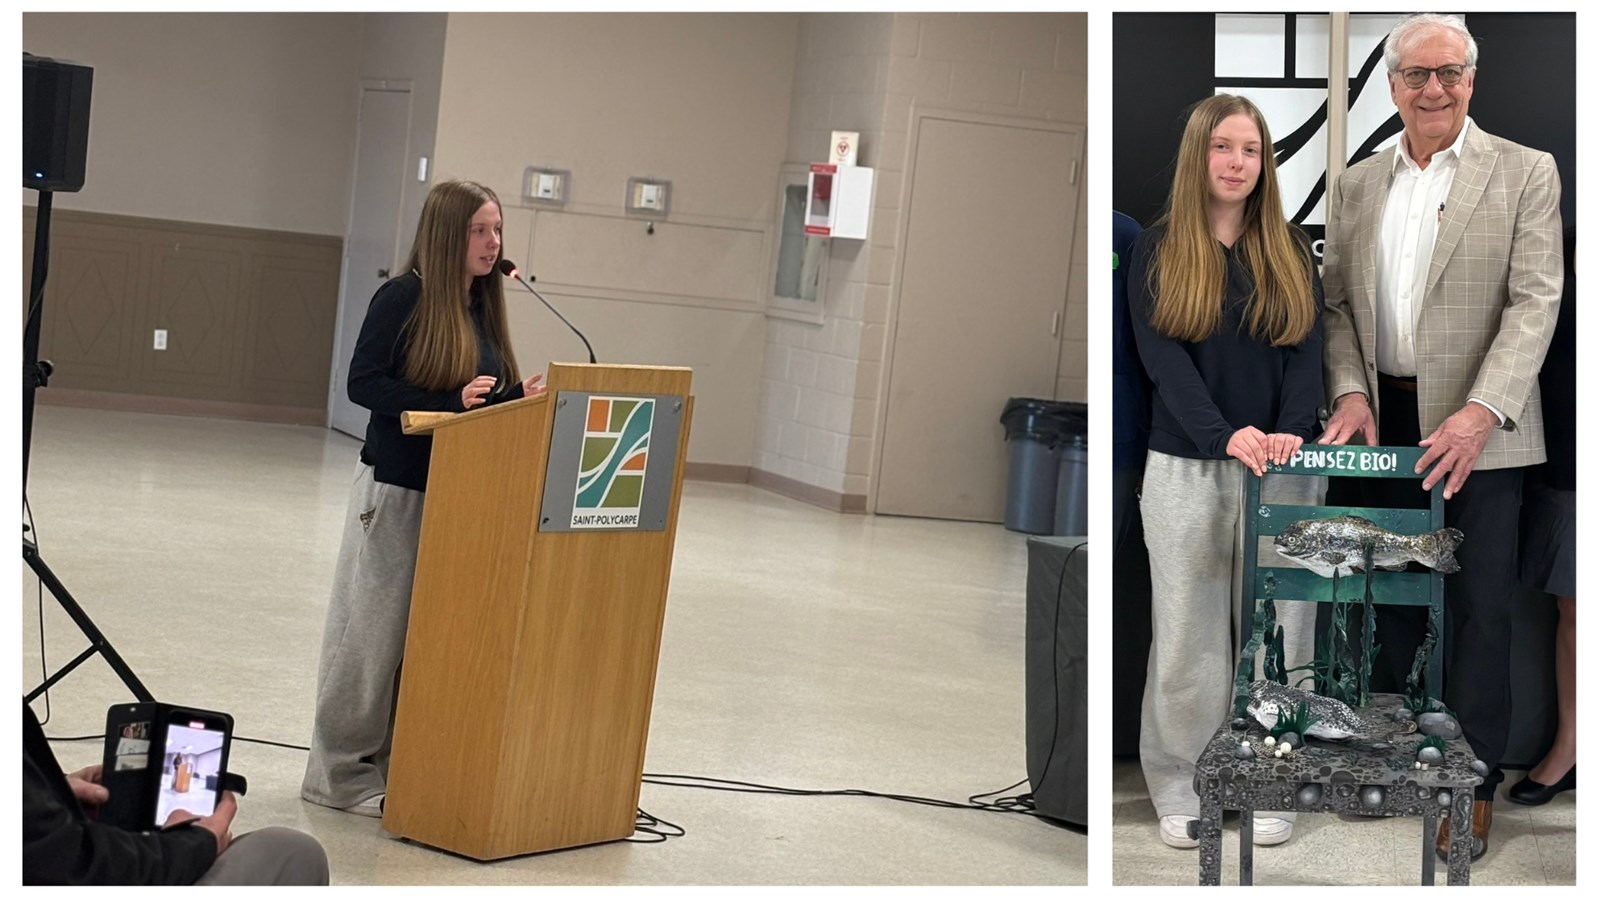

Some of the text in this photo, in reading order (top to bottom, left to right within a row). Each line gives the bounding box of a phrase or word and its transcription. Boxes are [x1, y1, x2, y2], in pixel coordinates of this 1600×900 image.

[1290, 449, 1397, 471] PENSEZ BIO!
[573, 515, 637, 525] SAINT-POLYCARPE
